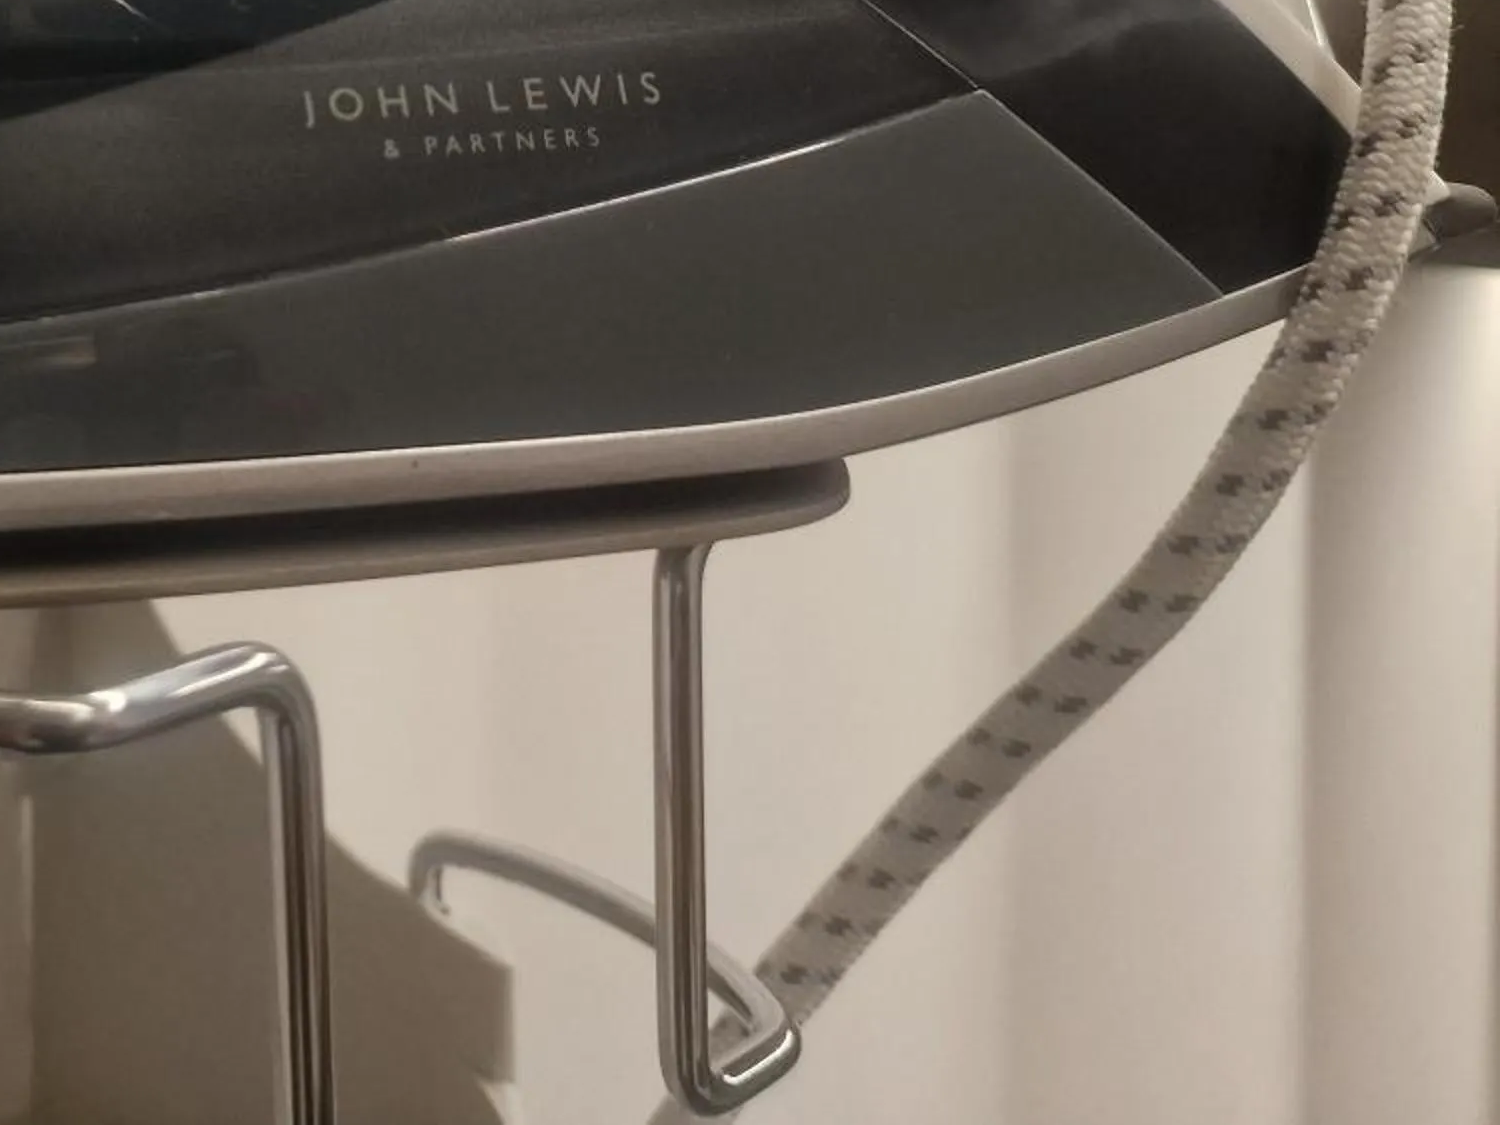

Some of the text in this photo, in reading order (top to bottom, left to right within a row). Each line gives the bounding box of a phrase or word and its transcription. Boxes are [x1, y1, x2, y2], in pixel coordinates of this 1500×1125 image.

[304, 71, 662, 129] JOHN LEWIS
[383, 126, 600, 159] & PARTNERS
